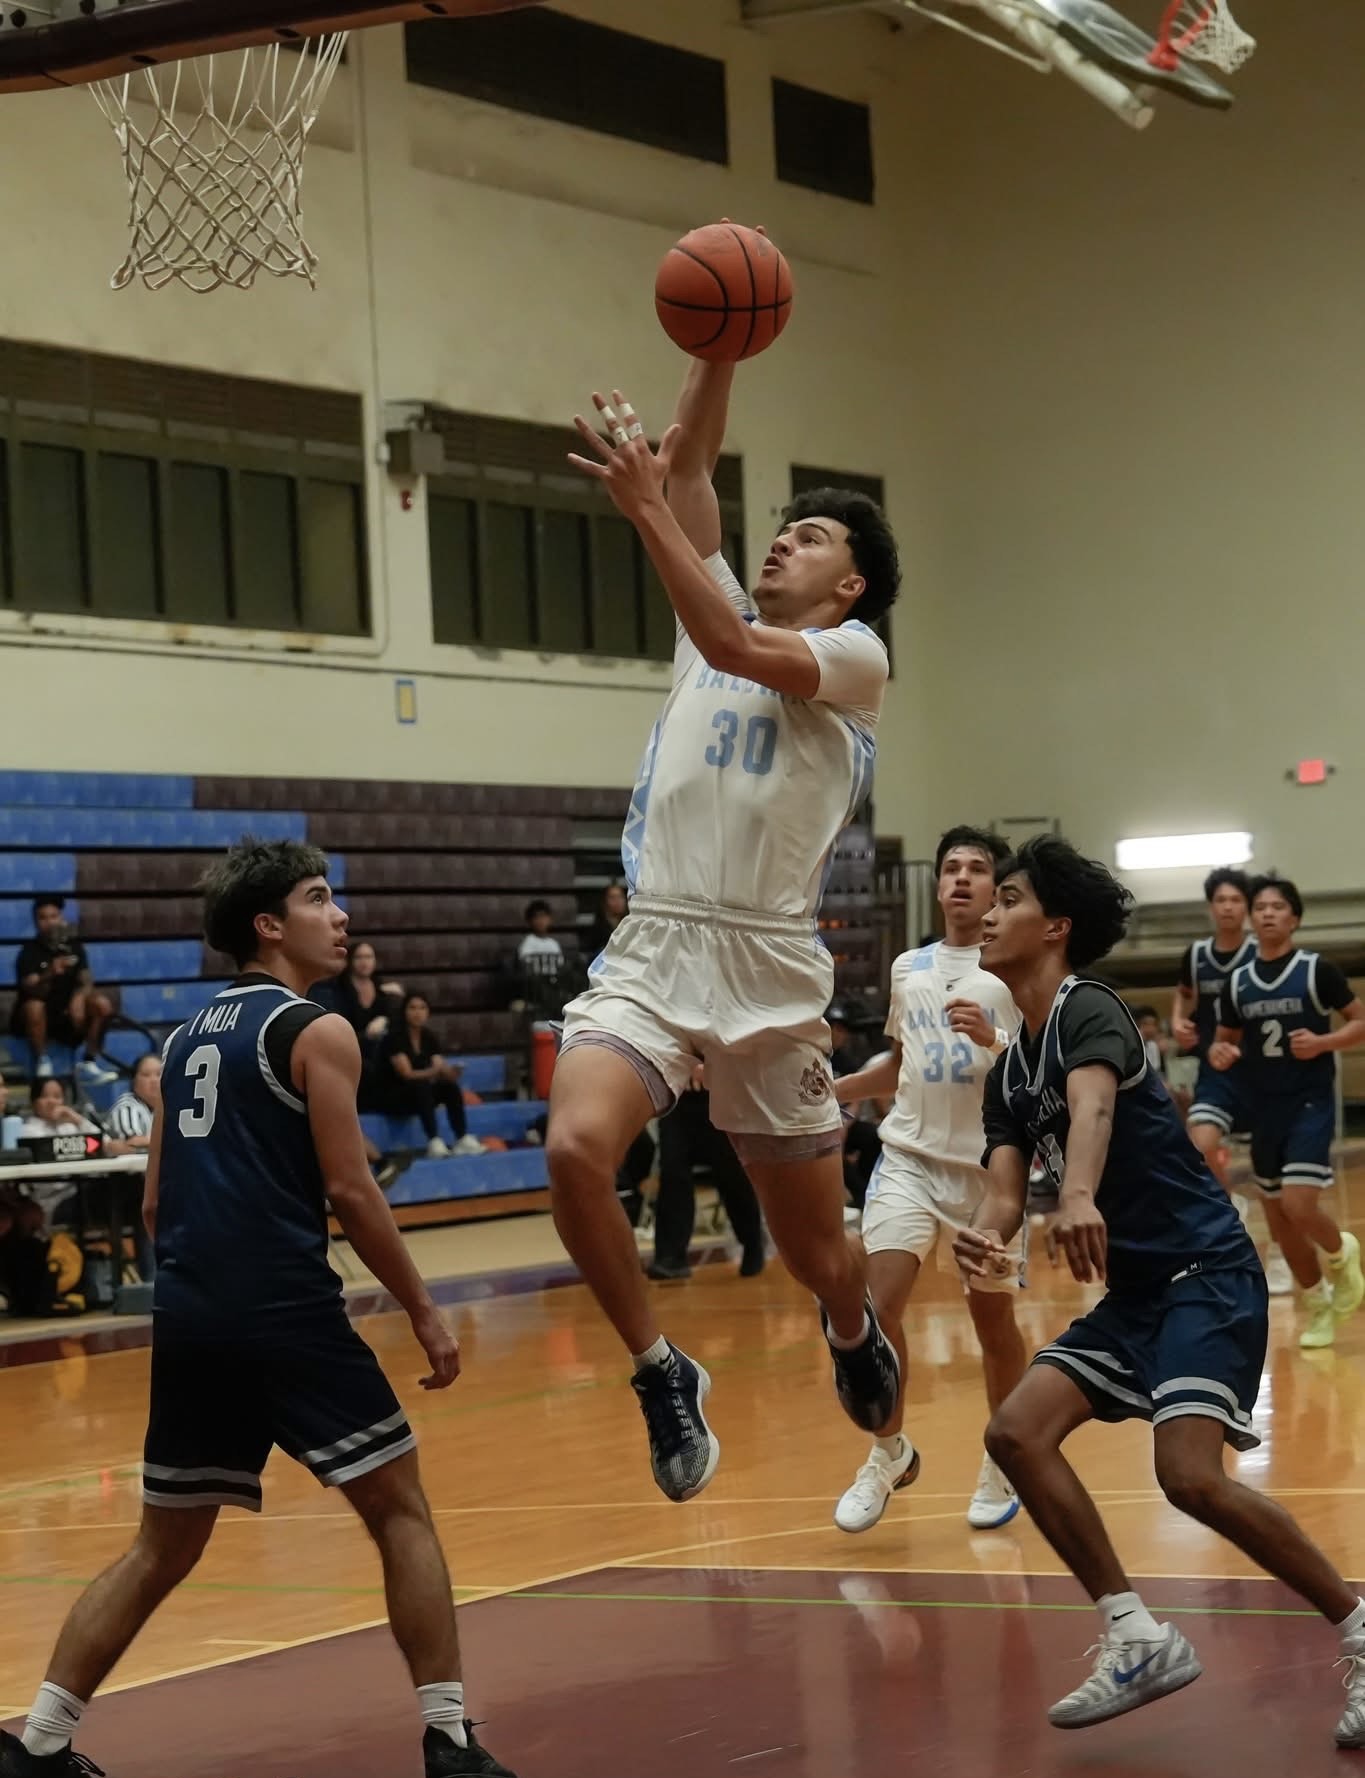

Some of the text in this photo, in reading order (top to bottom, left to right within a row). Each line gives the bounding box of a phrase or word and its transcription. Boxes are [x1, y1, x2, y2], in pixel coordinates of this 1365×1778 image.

[704, 708, 778, 776] 30
[188, 1002, 243, 1037] I MUA
[1261, 1019, 1284, 1057] 2
[923, 1042, 975, 1083] 32
[178, 1044, 221, 1137] 3
